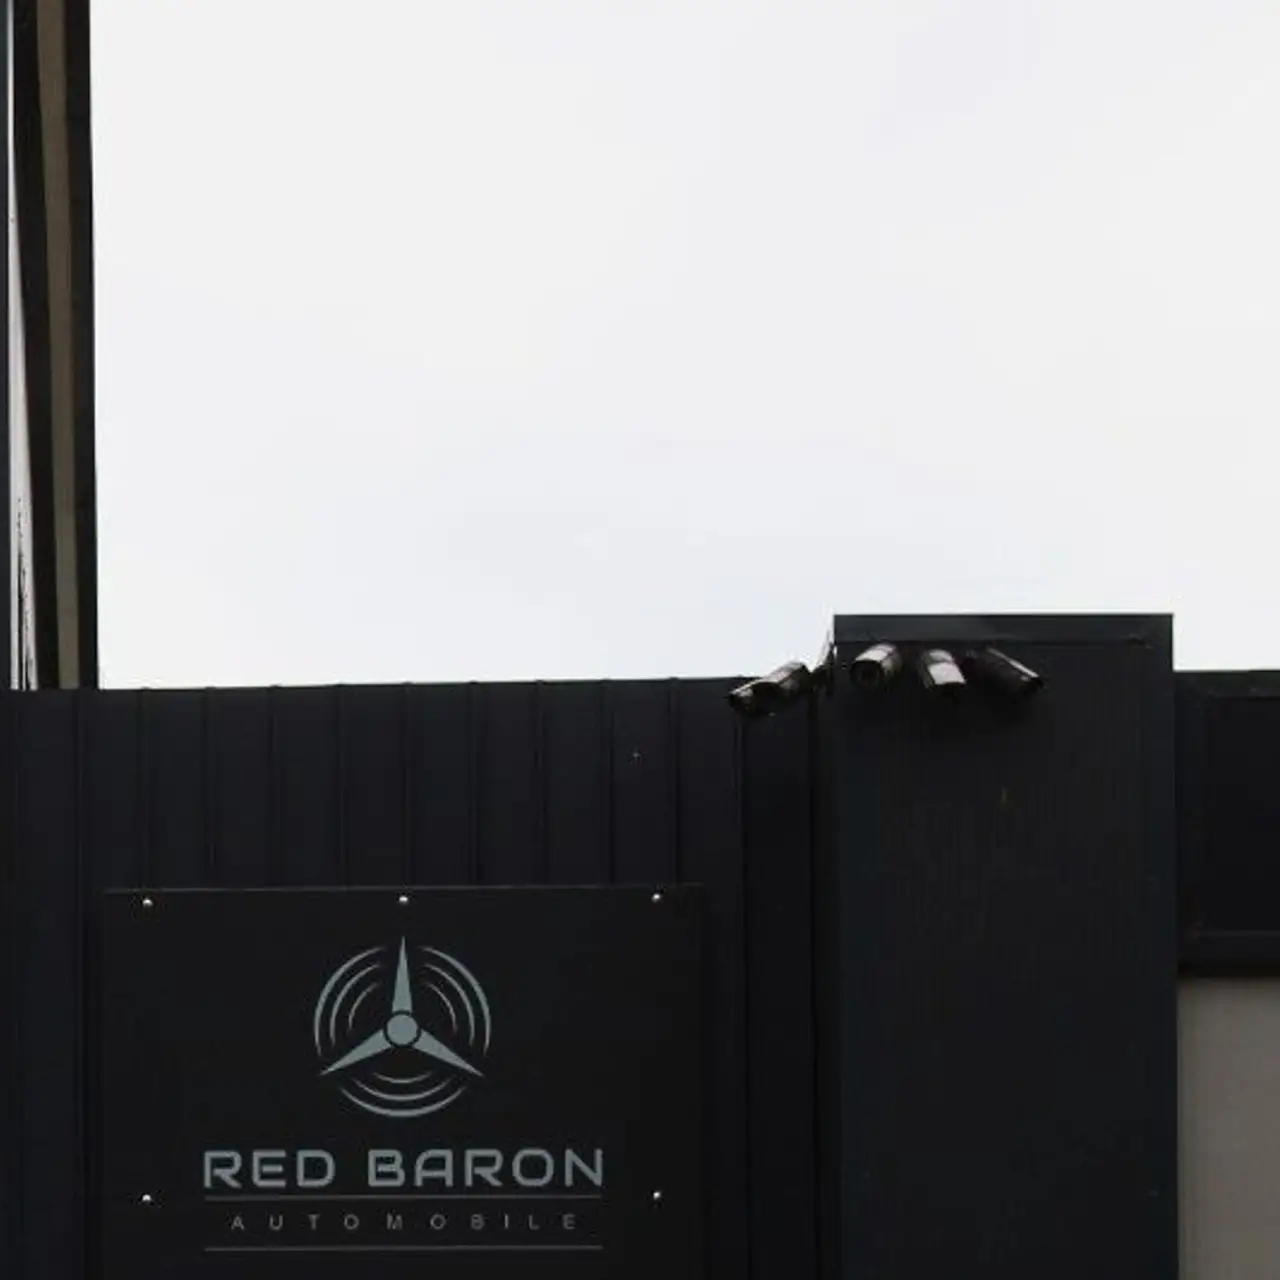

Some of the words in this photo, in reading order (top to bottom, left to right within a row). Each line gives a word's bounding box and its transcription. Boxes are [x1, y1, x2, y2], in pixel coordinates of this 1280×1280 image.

[203, 1149, 336, 1189] RED
[366, 1147, 604, 1188] BARON
[230, 1212, 577, 1231] AUTOMOBILE
